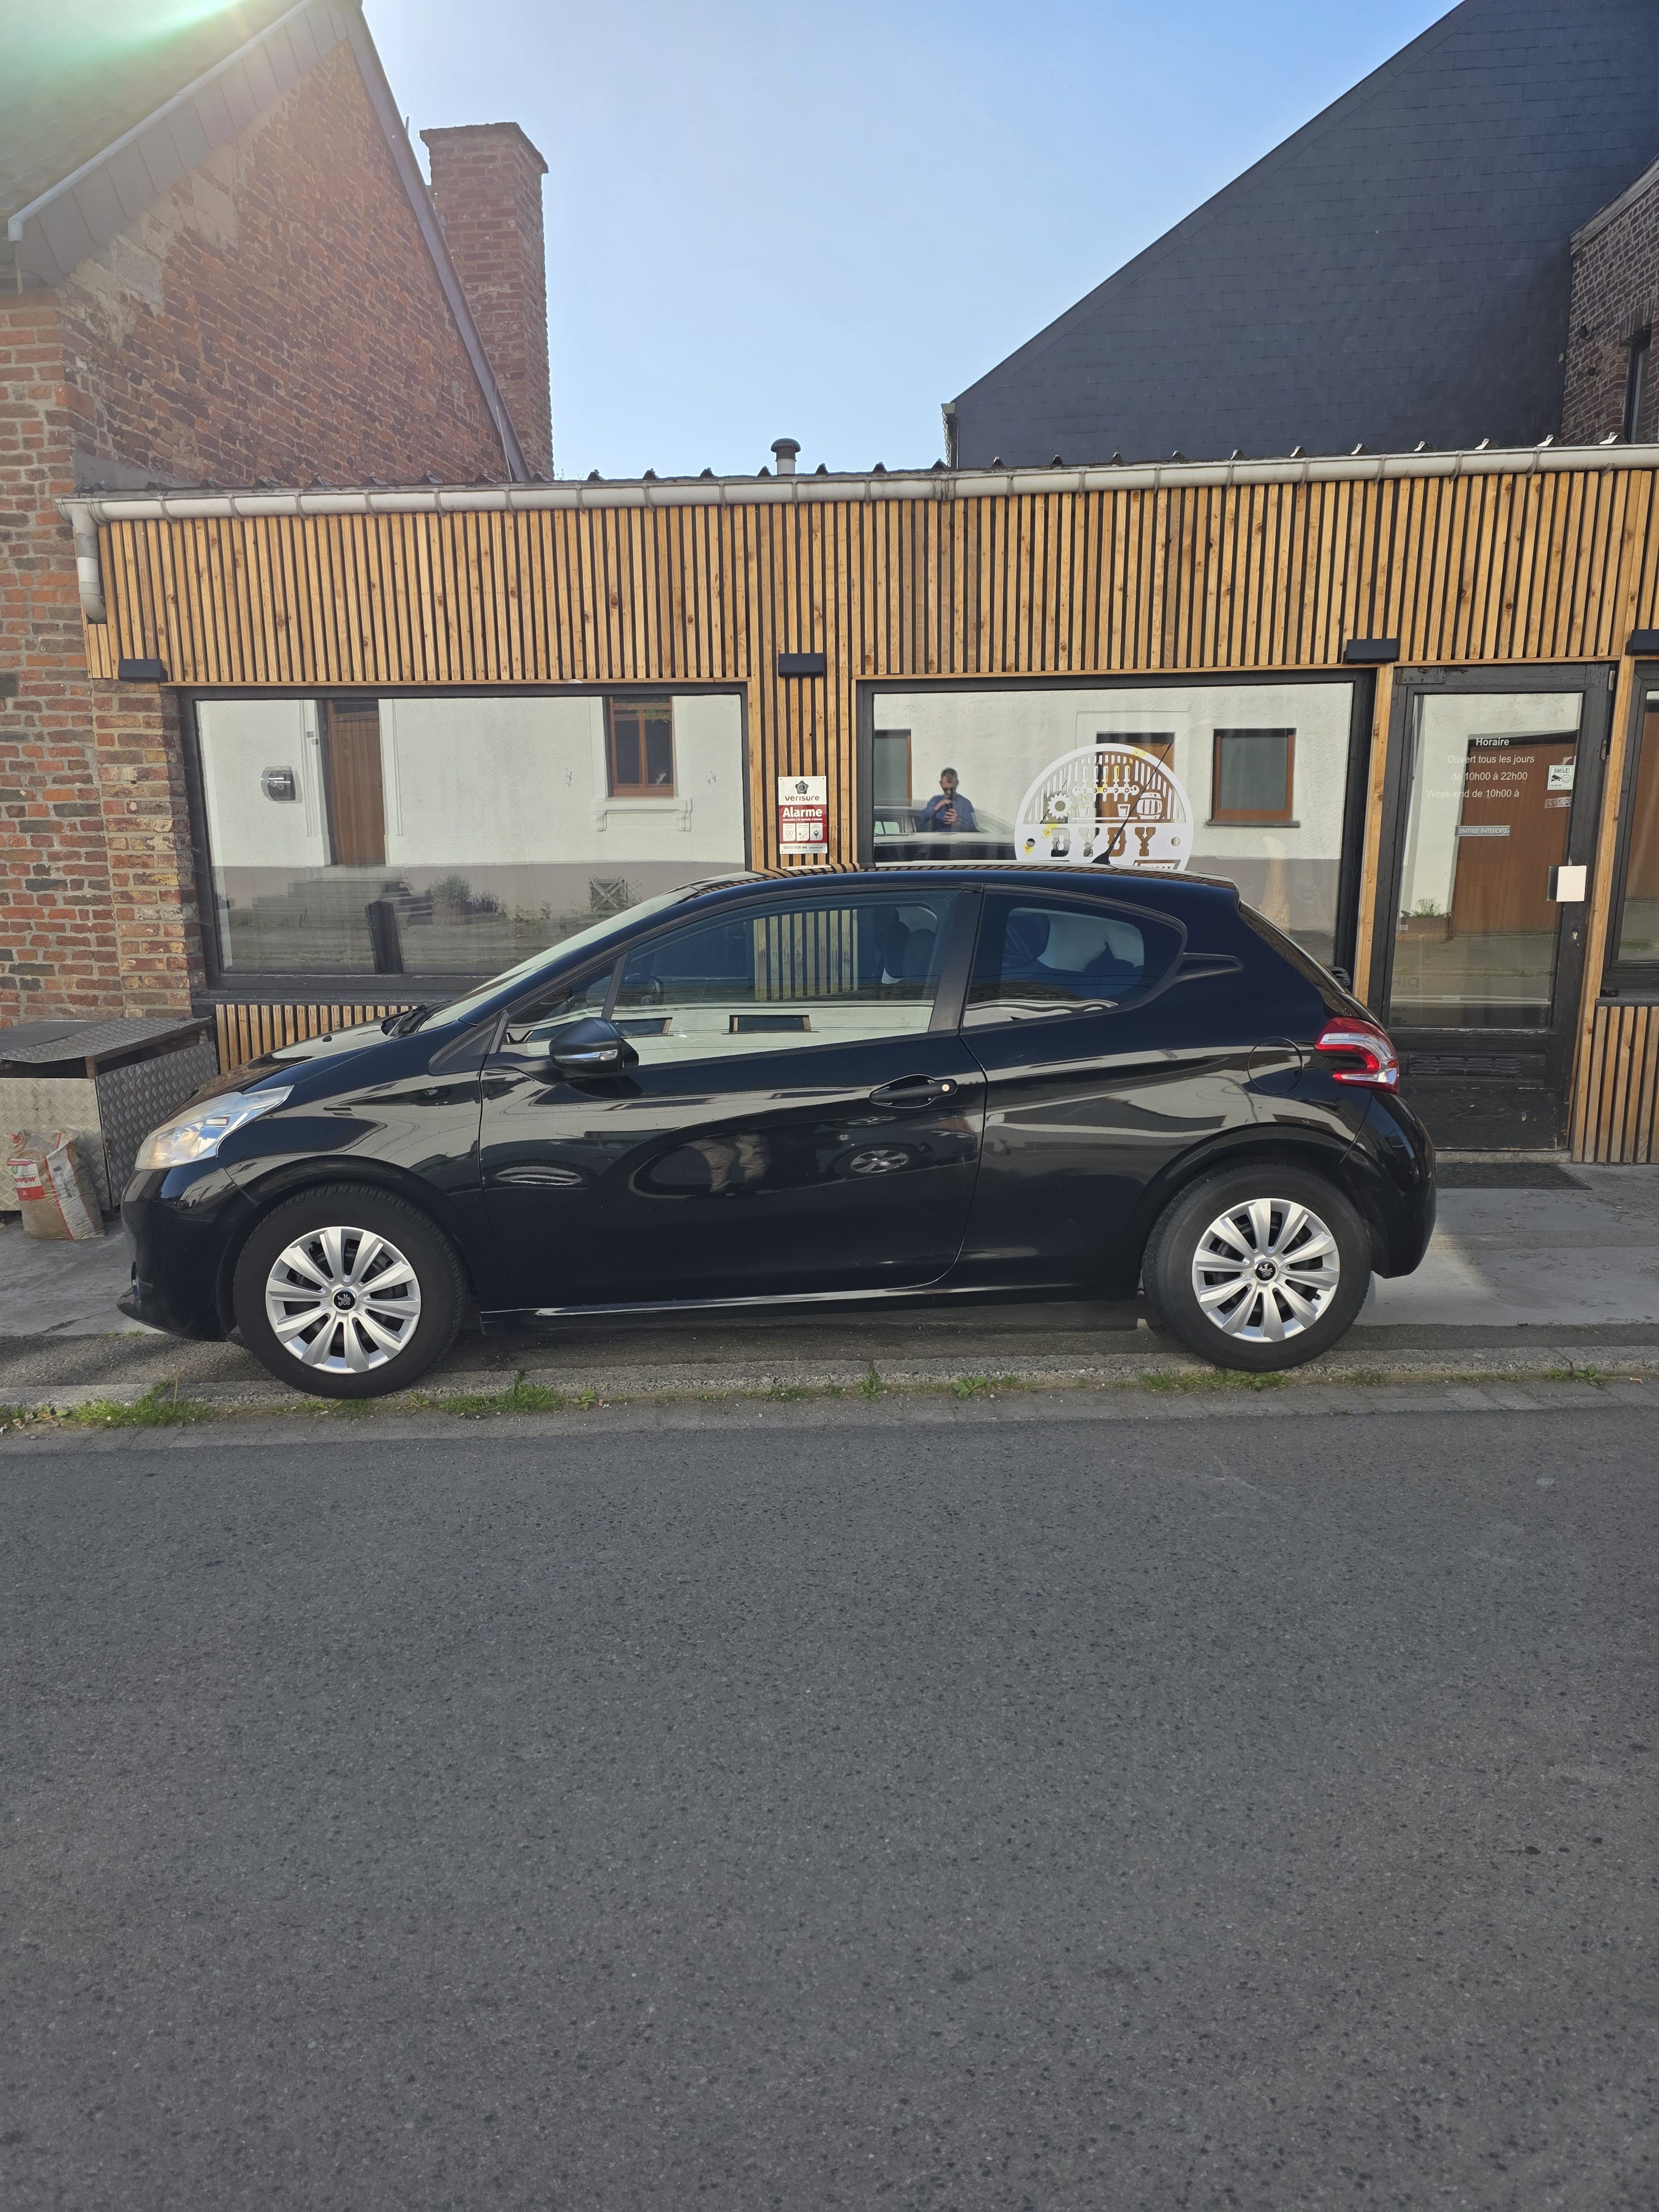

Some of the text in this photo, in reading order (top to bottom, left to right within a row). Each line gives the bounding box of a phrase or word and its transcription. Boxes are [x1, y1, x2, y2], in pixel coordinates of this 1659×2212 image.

[1475, 737, 1510, 746] Horaire
[1447, 755, 1476, 763] Ouvert
[1512, 754, 1535, 765] jours
[1451, 771, 1528, 780] de 10h00 à 22h00
[1426, 789, 1520, 797] Week-end de 10h00 à
[782, 807, 822, 817] Alarme
